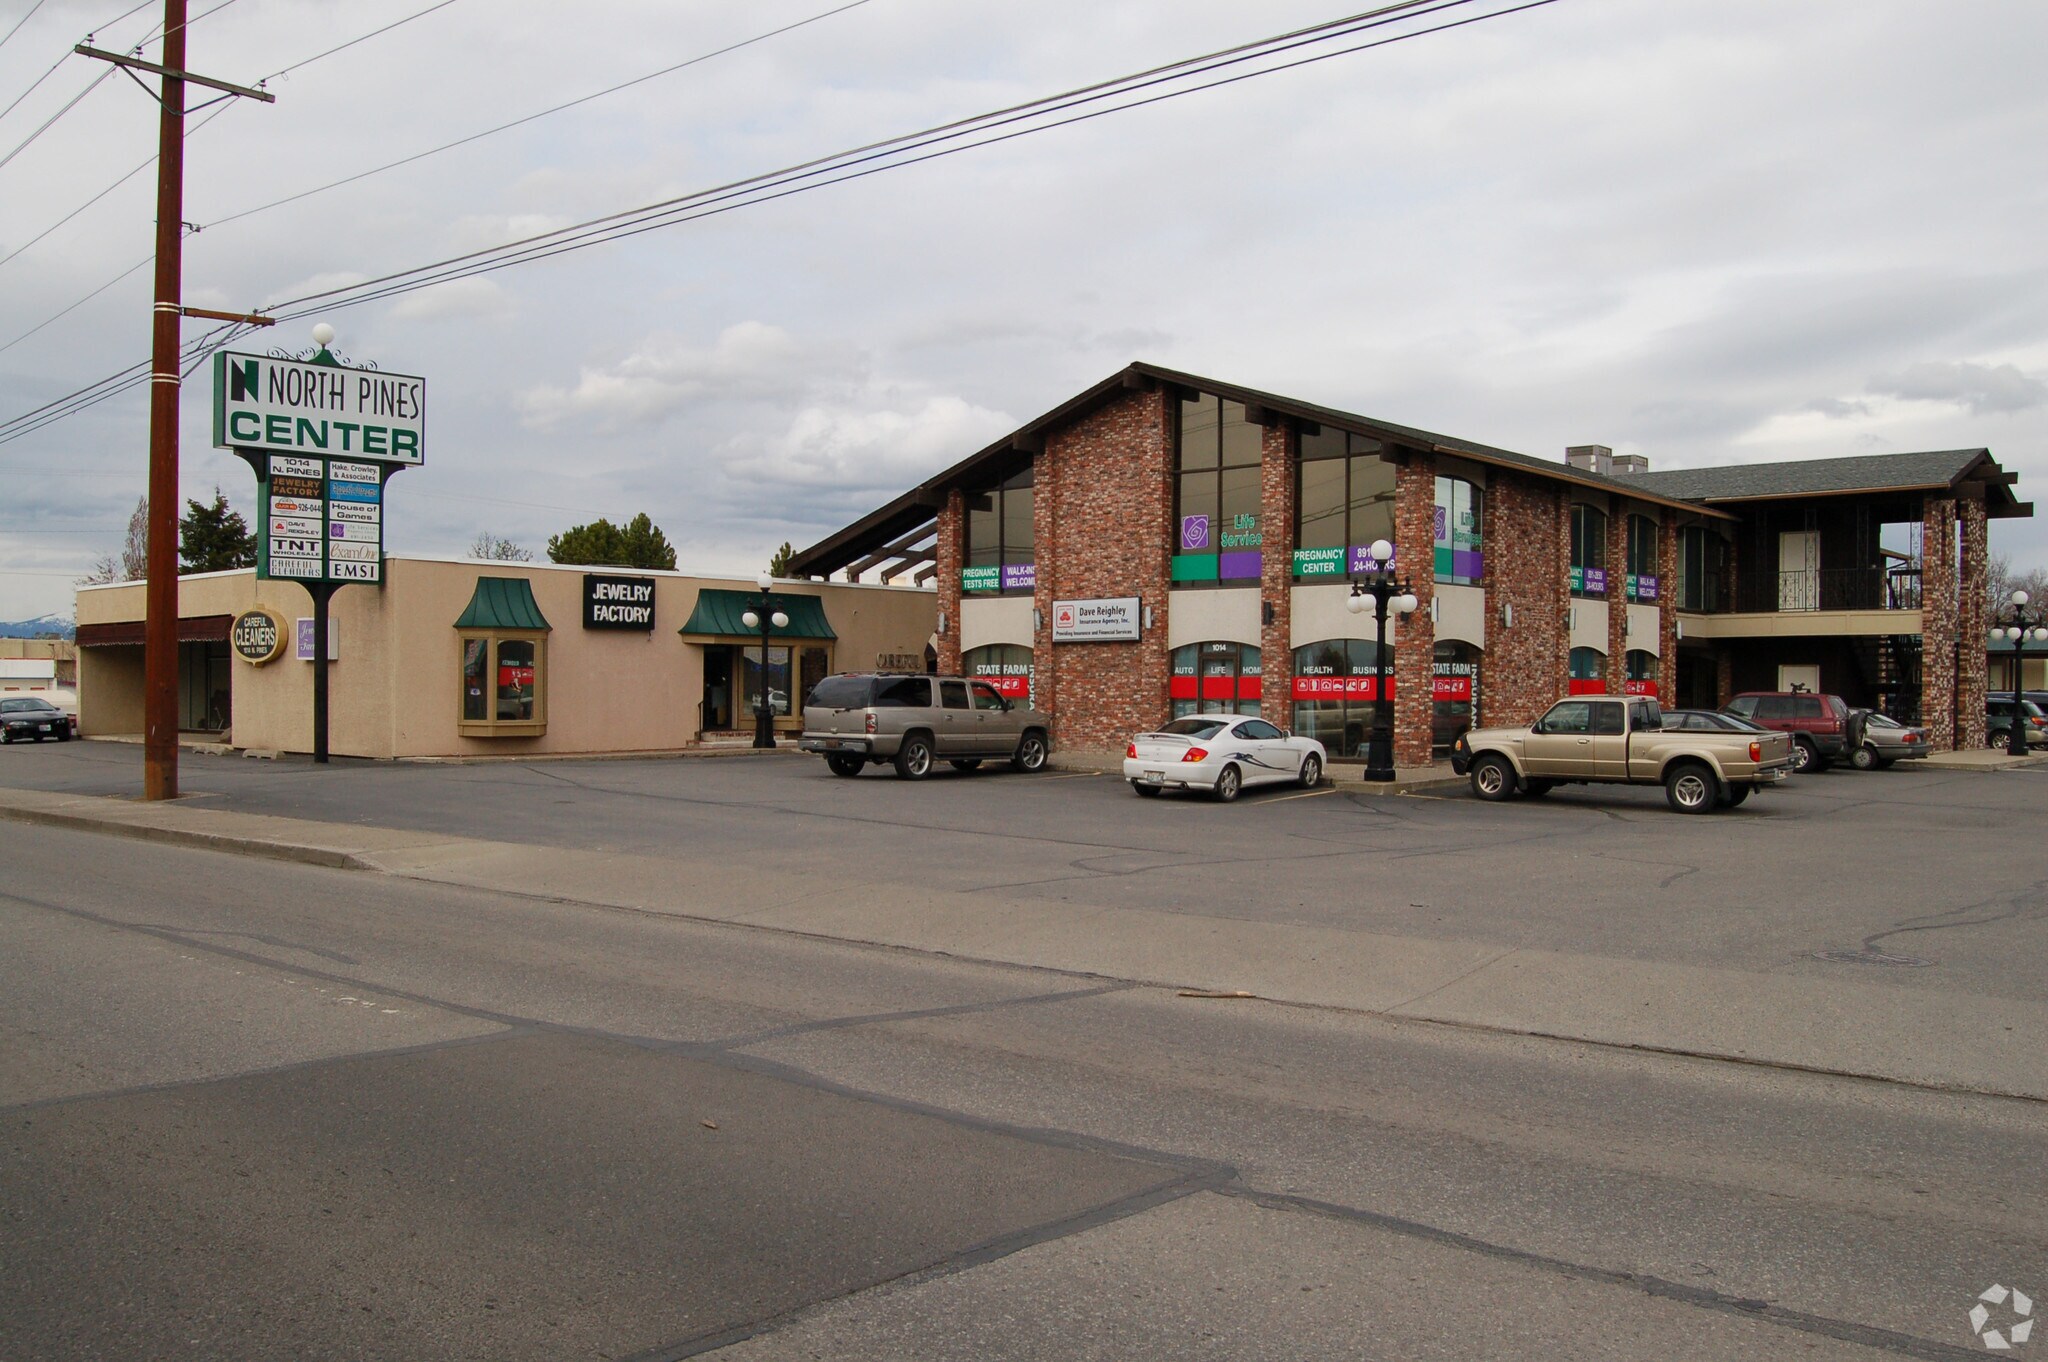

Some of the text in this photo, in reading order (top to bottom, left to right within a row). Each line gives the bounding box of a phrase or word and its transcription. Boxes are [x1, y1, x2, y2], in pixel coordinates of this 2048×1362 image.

[269, 365, 419, 420] NORTH PINES
[230, 411, 419, 458] CENTER
[284, 458, 310, 466] 1014
[286, 467, 321, 476] PINES
[341, 473, 376, 481] Associates
[273, 477, 320, 488] JEWELRY
[273, 486, 320, 496] FACTORY
[332, 503, 365, 512] House
[337, 511, 373, 520] Games
[1461, 511, 1475, 528] Life
[1234, 513, 1255, 530] Life
[273, 539, 320, 551] TNT
[1294, 548, 1344, 561] PREGNANCY
[272, 559, 312, 569] CAREFUL
[1302, 562, 1335, 574] CENTER
[1354, 559, 1396, 571] 24-HORS
[272, 567, 320, 577] CLEANERS
[334, 564, 374, 578] EMSI
[963, 567, 1000, 577] PREGNANCY
[964, 578, 999, 588] TESTS FREE
[592, 583, 652, 601] JEWELRY
[594, 605, 651, 623] FACTORY
[1080, 605, 1126, 617] Dave Reighley
[244, 617, 267, 627] CAREFUL
[235, 627, 275, 646] CLEANERS
[976, 664, 1028, 675] STATE FARM
[1175, 666, 1194, 674] AUTO
[1211, 666, 1226, 674] LIFE
[1243, 666, 1261, 674] HOM
[1303, 666, 1333, 674] HEALTH
[1452, 663, 1471, 674] FARM
